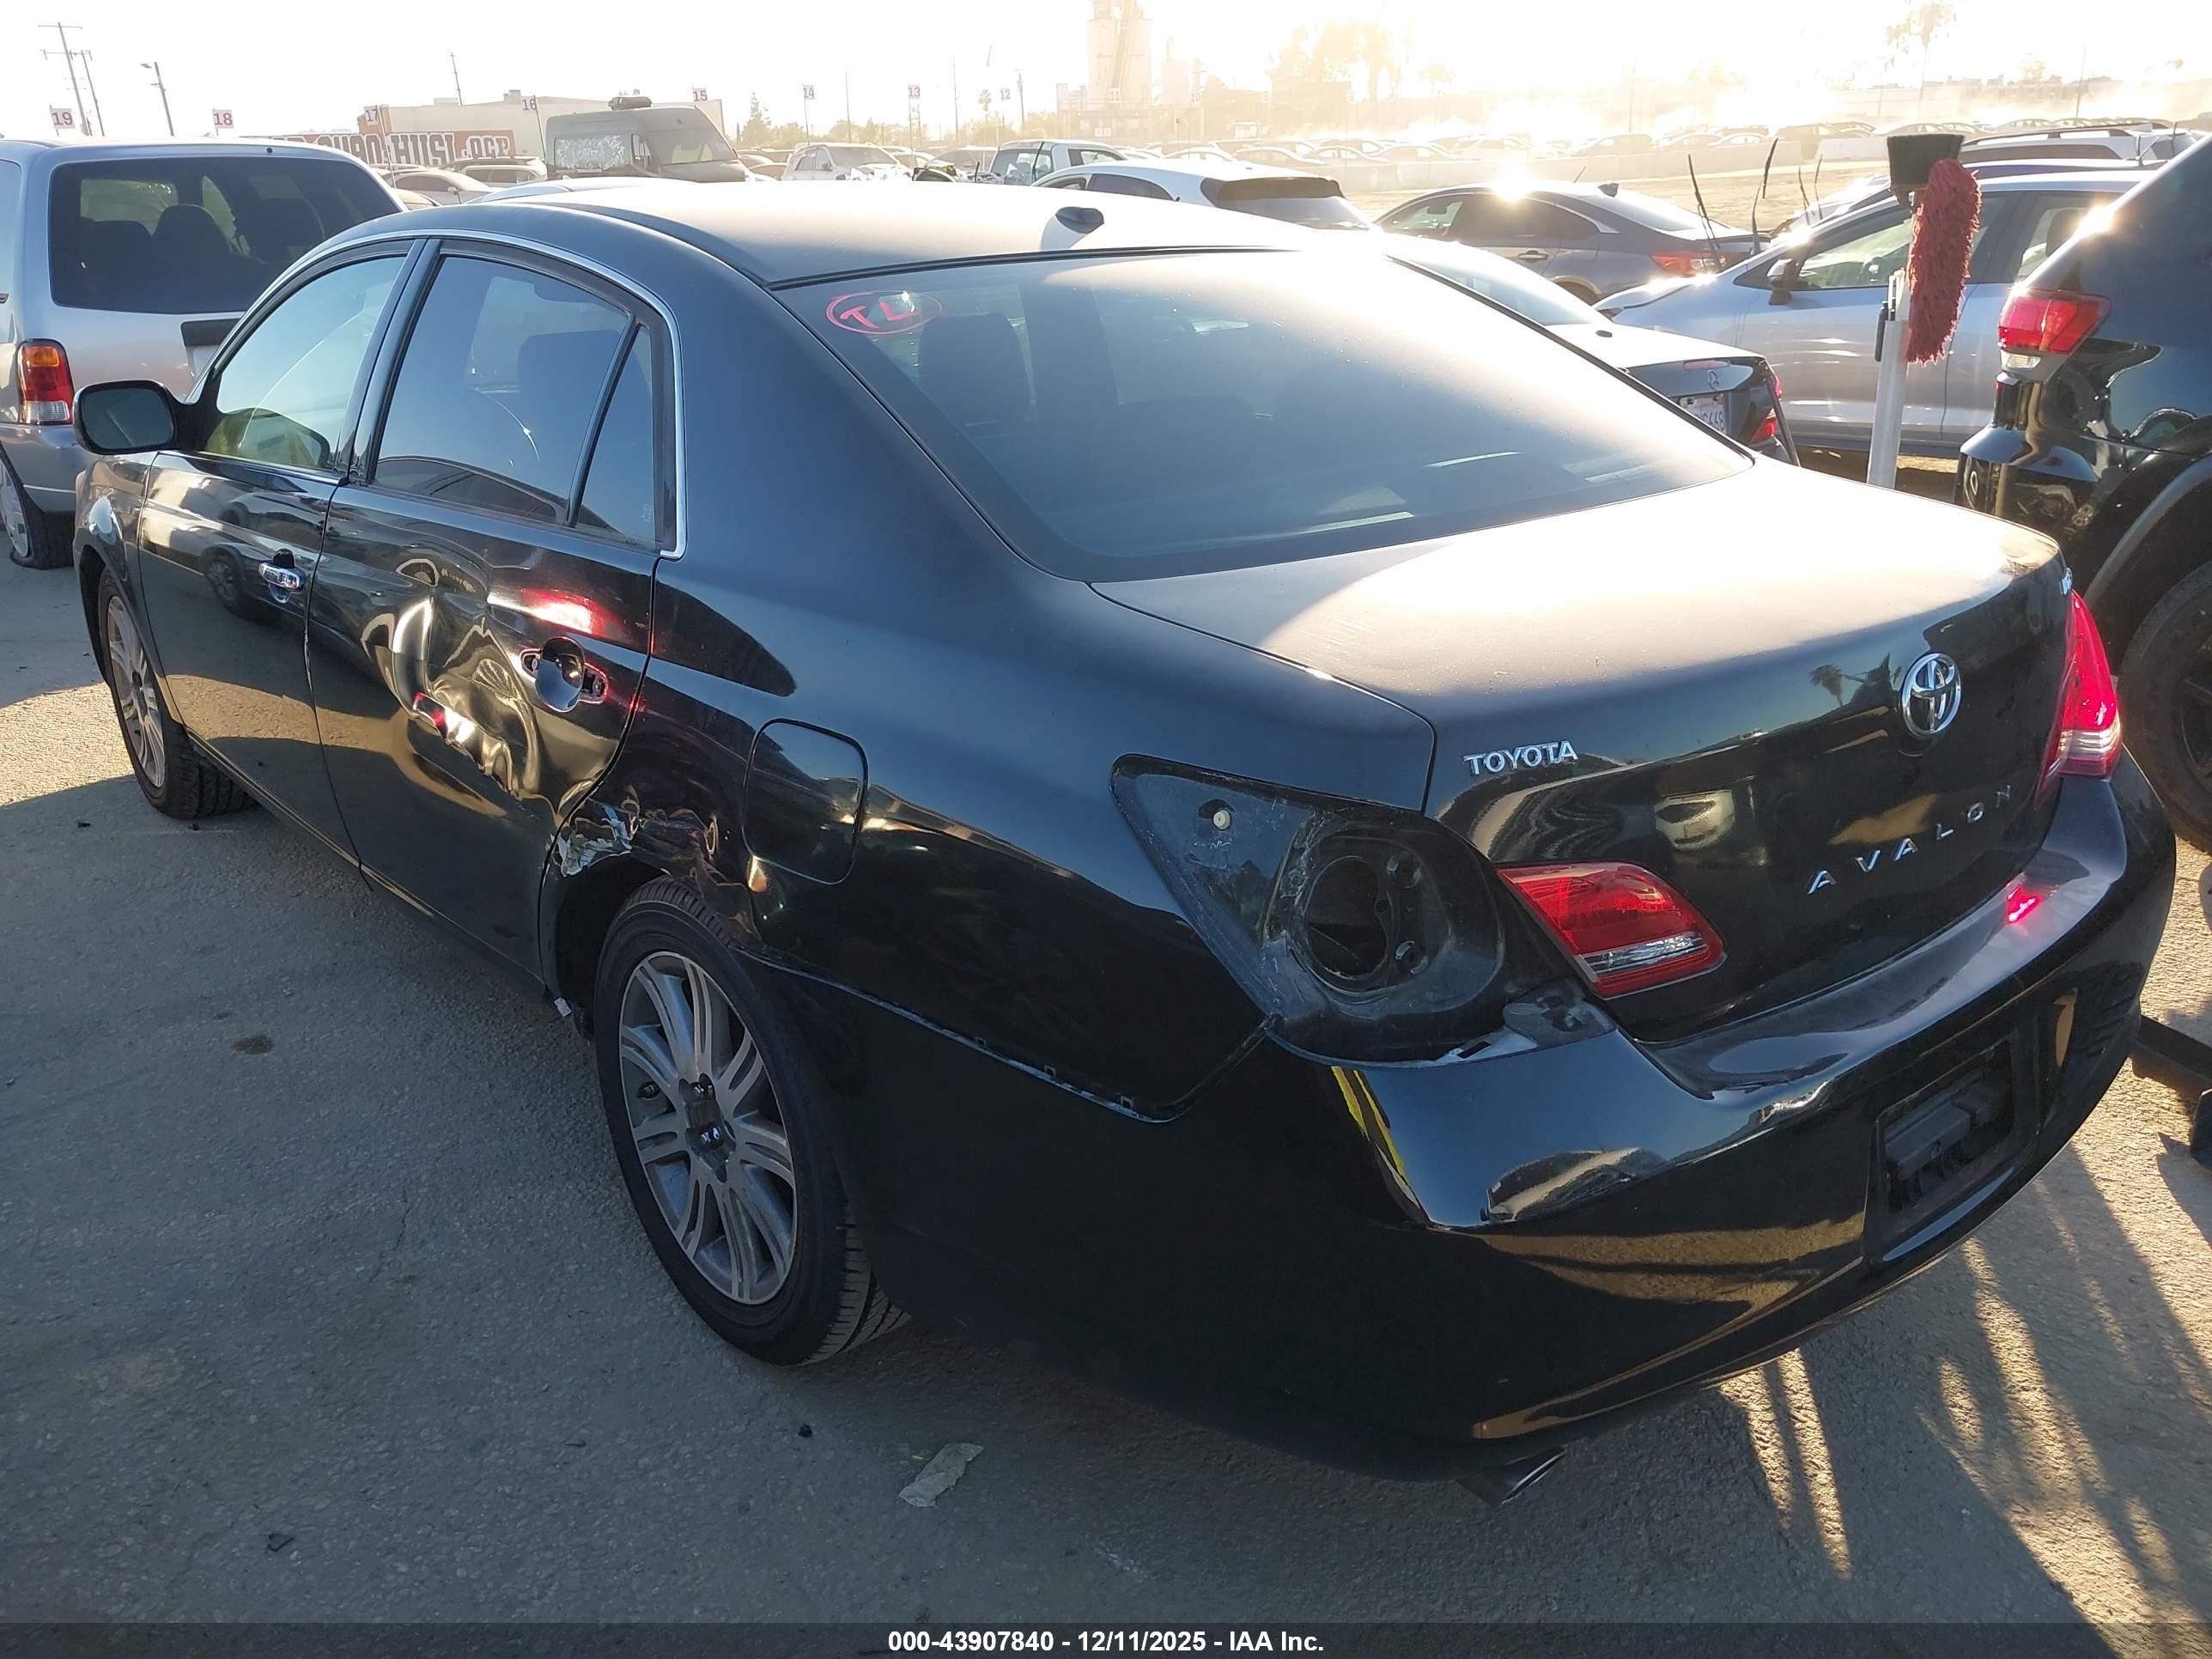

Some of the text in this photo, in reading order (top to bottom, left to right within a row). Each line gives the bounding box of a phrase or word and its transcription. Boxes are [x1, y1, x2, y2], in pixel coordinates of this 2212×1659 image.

[693, 90, 708, 102] 15
[803, 87, 814, 99] 14
[908, 87, 921, 97] 13
[1000, 88, 1011, 100] 12
[522, 98, 537, 111] 16
[52, 112, 73, 125] 19
[214, 112, 233, 125] 18
[366, 109, 378, 122] 17
[1463, 740, 1580, 775] TOYOTA
[1807, 784, 2012, 895] AVALON
